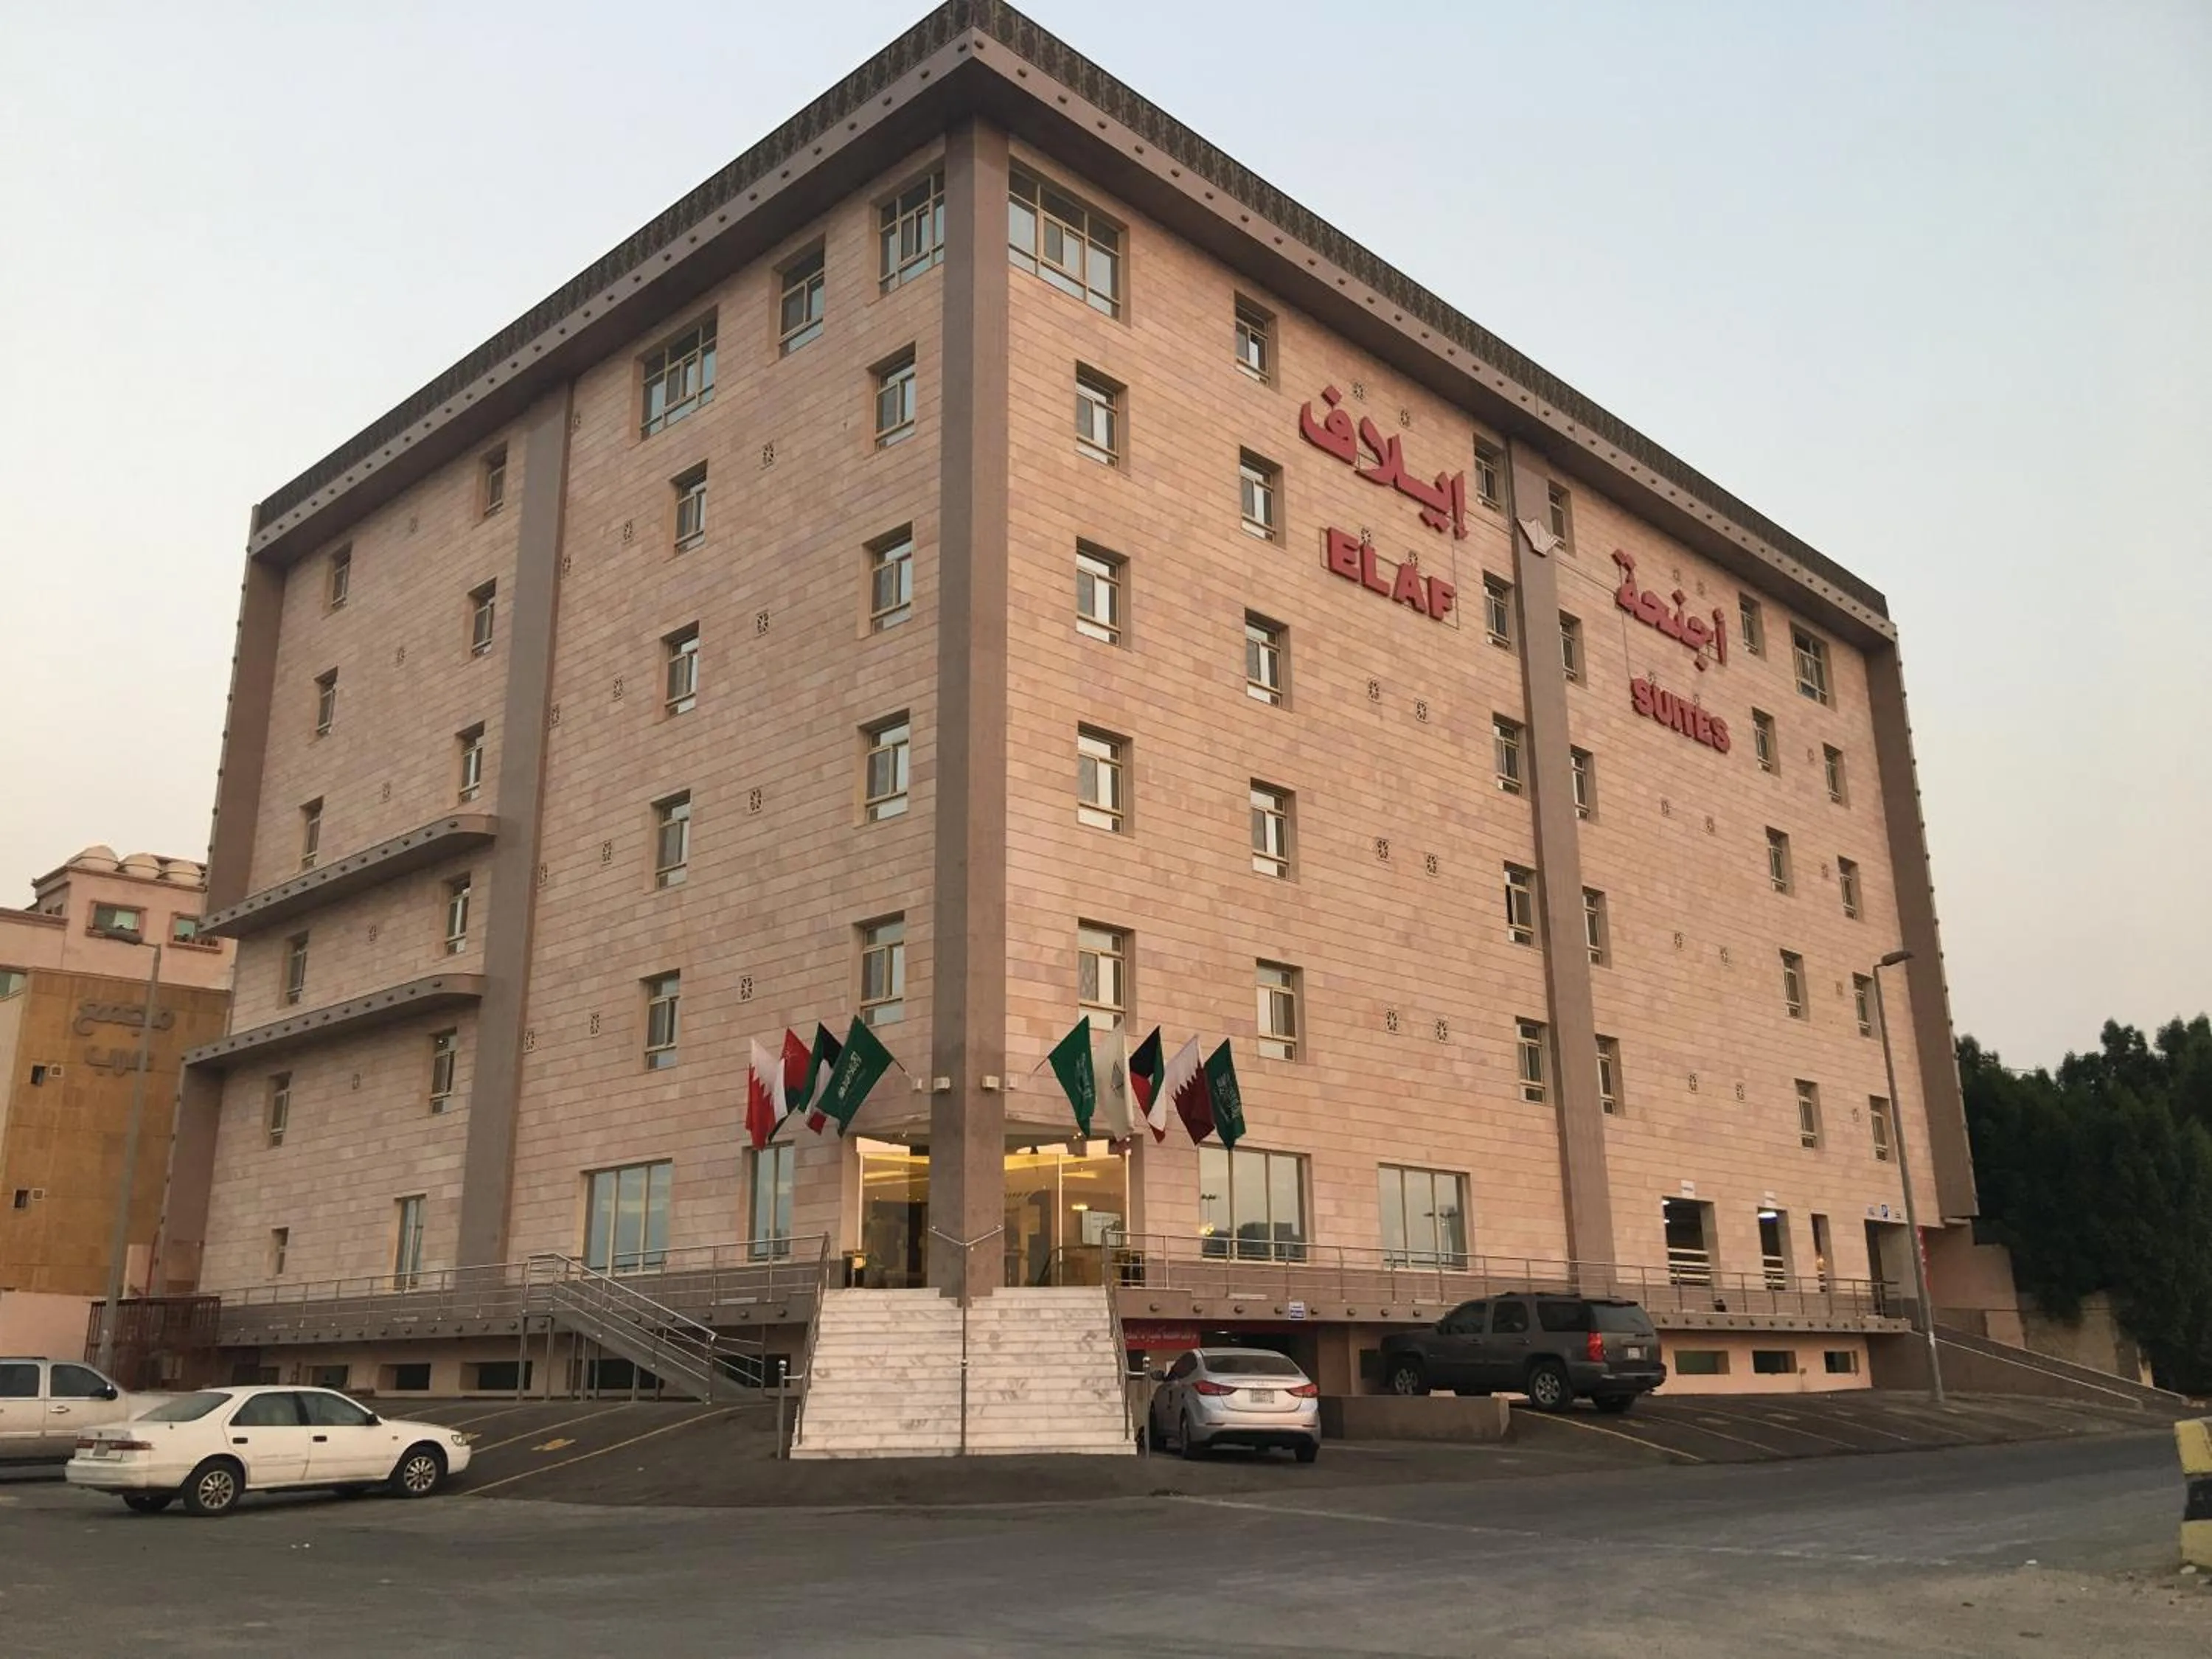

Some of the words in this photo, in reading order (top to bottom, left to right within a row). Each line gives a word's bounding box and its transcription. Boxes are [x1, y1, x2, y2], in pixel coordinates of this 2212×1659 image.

[1298, 384, 1470, 540] إيلاف
[1327, 526, 1455, 622] ELAF
[1610, 549, 1728, 672] أجنحة
[1630, 678, 1731, 754] SUITES
